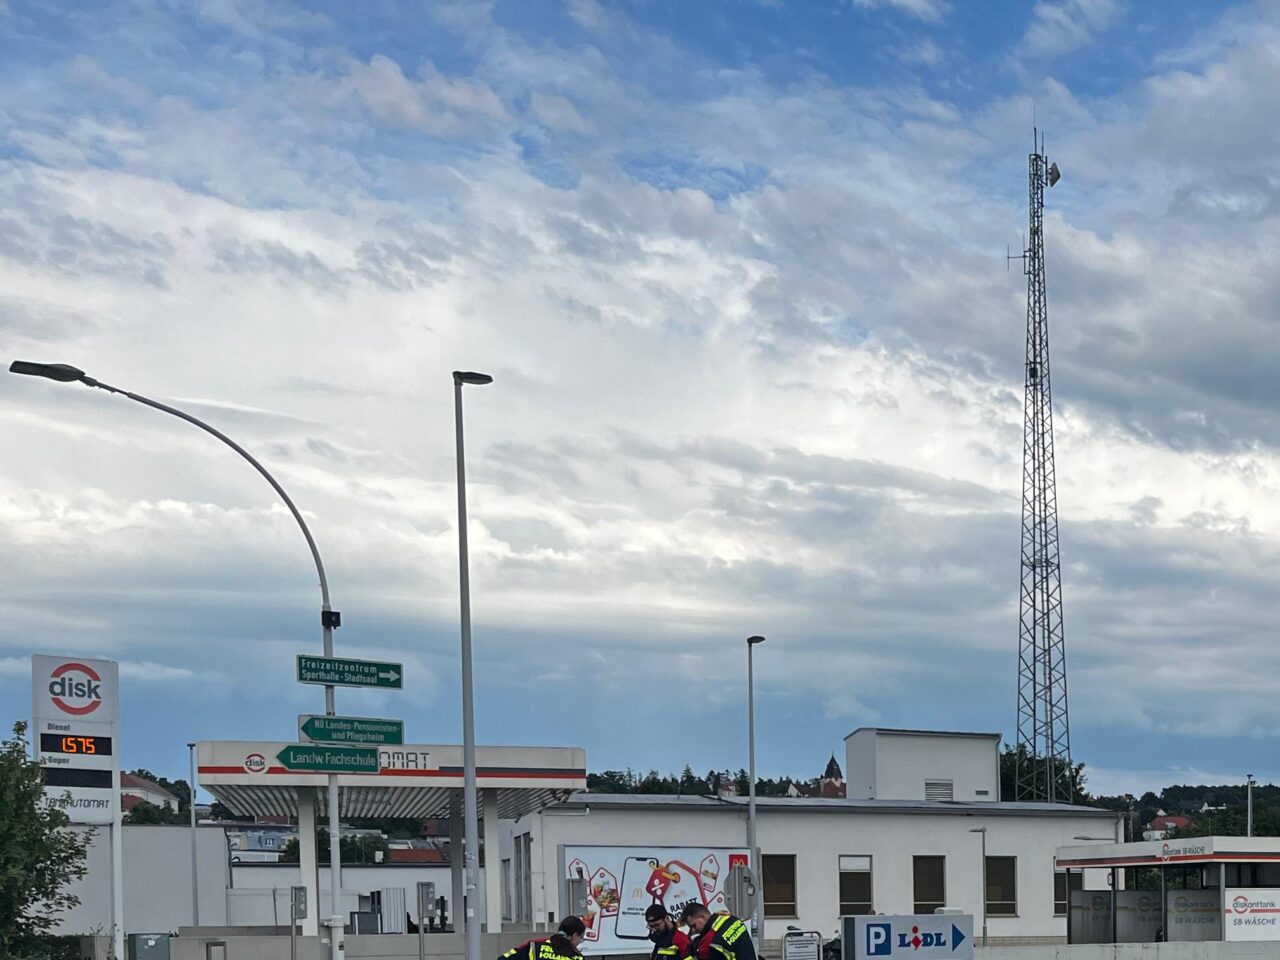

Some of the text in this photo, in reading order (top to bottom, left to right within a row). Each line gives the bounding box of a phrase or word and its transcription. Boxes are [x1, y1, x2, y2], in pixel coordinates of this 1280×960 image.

[301, 659, 378, 674] Freizeitzentrum
[48, 677, 102, 699] disk
[47, 723, 71, 731] Diesel
[331, 730, 385, 742] und Pflegeheim
[245, 759, 266, 767] disk
[325, 753, 377, 767] Fachschule
[1232, 900, 1276, 909] diskonttank
[869, 927, 886, 954] P
